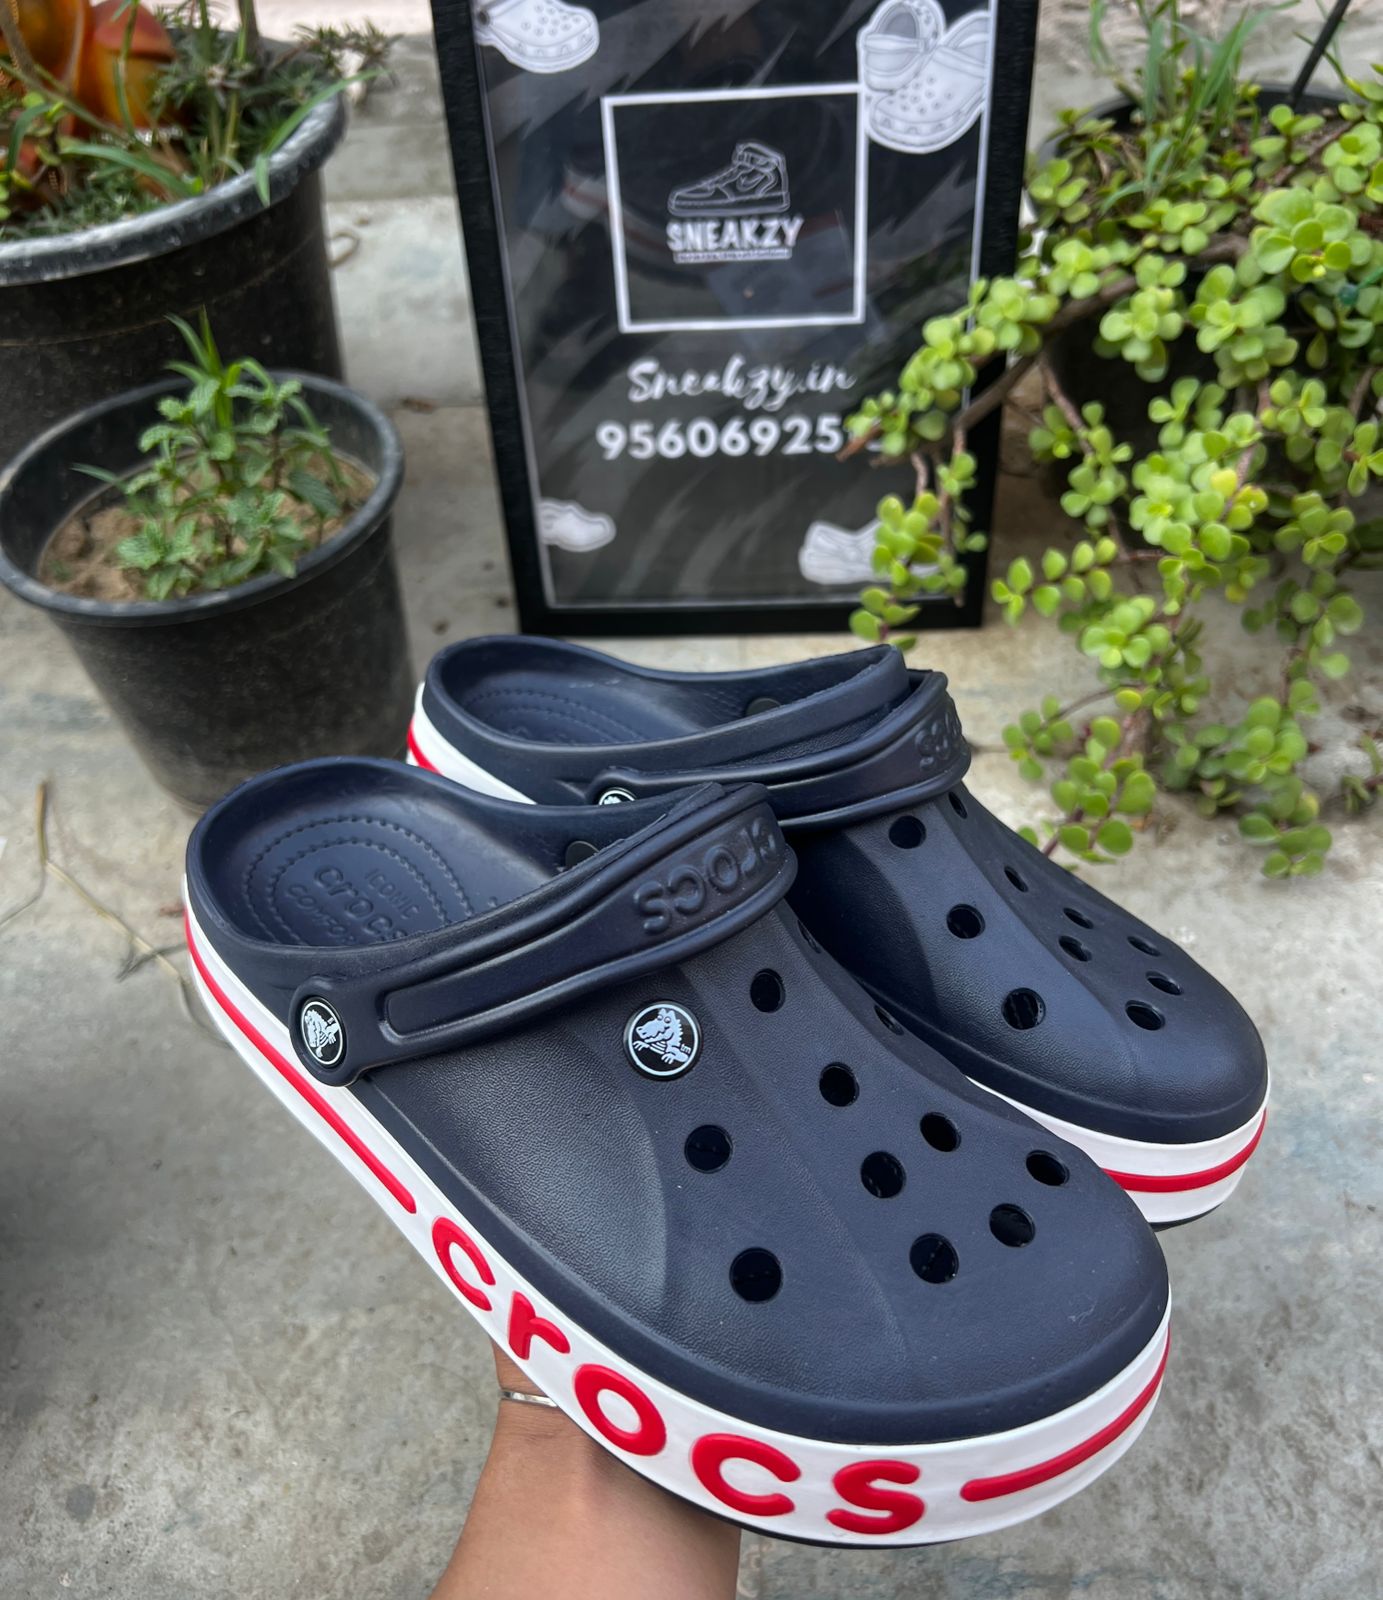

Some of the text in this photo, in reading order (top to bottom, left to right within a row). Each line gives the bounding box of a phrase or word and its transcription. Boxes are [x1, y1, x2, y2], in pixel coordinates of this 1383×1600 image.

[666, 214, 804, 252] SNEAKZY
[626, 353, 856, 411] Sneakzy.in
[596, 413, 886, 460] 95606925
[432, 1216, 926, 1535] crocs
